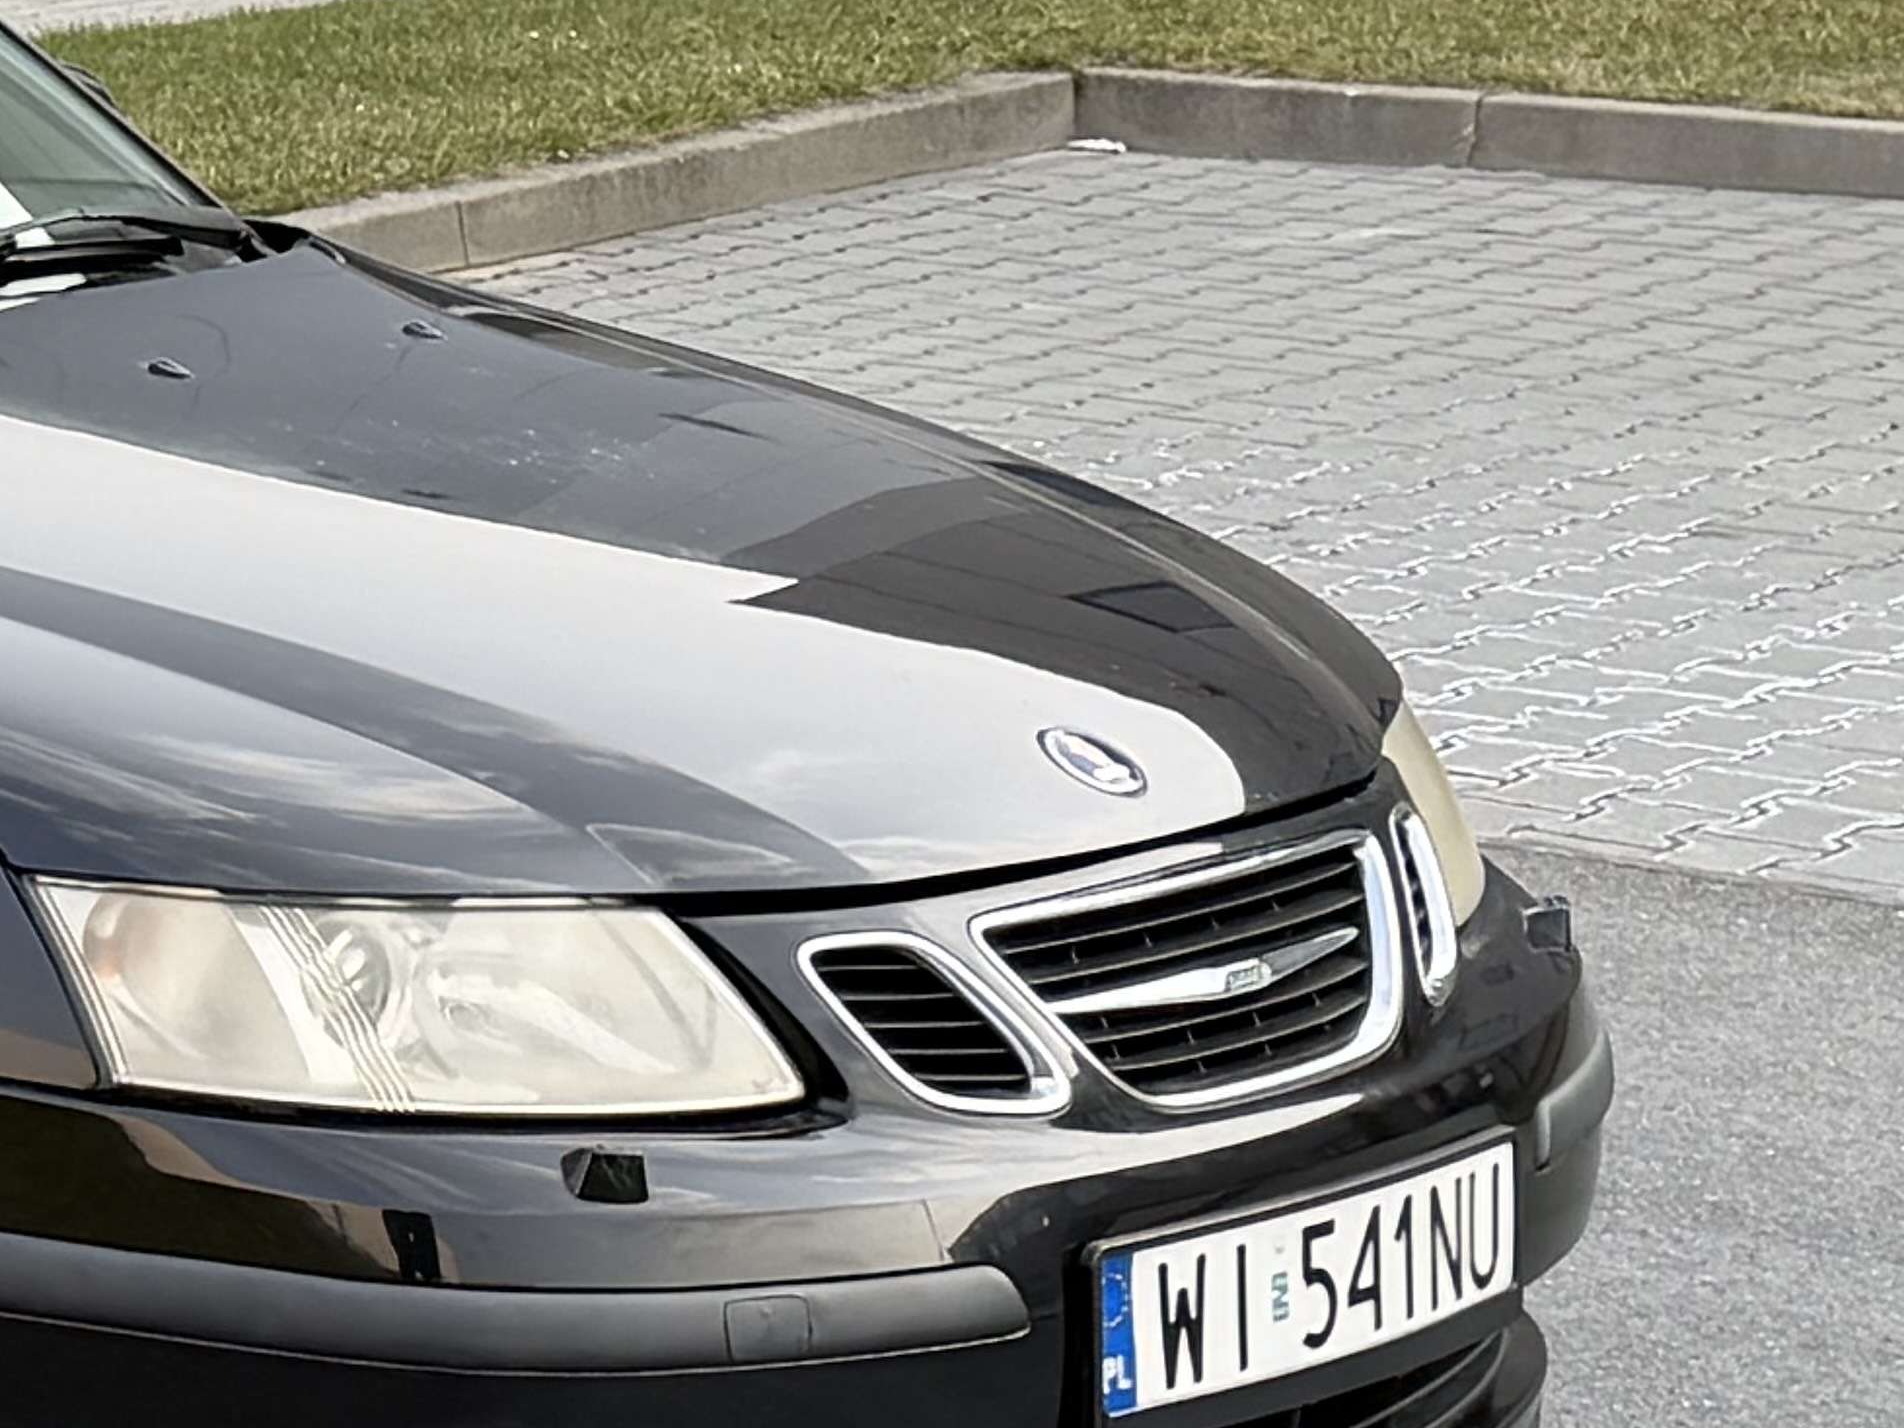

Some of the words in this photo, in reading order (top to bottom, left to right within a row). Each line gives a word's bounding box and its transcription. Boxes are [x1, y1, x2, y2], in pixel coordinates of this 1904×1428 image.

[1158, 1244, 1249, 1390] WI
[1302, 1163, 1500, 1350] 541NU
[1103, 1354, 1132, 1394] PL
